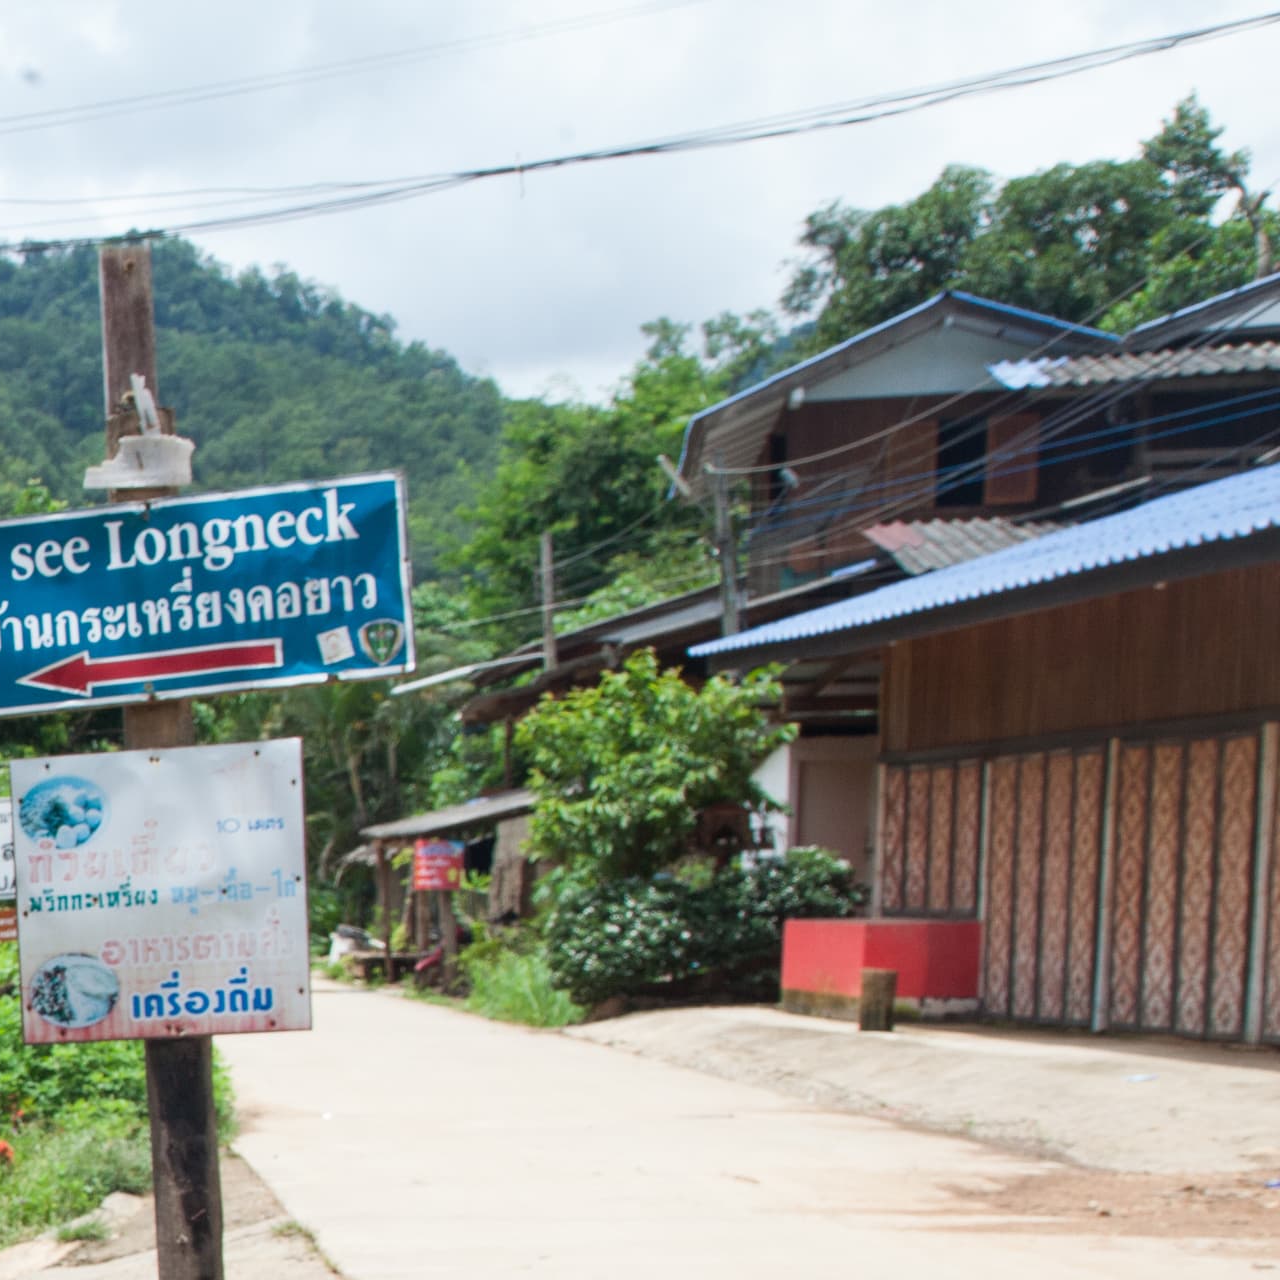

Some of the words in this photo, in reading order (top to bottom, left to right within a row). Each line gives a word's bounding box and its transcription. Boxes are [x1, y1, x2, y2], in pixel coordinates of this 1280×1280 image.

[10, 536, 92, 581] see
[104, 488, 360, 571] Longneck
[132, 966, 274, 1019] เครื่องดื่ม
